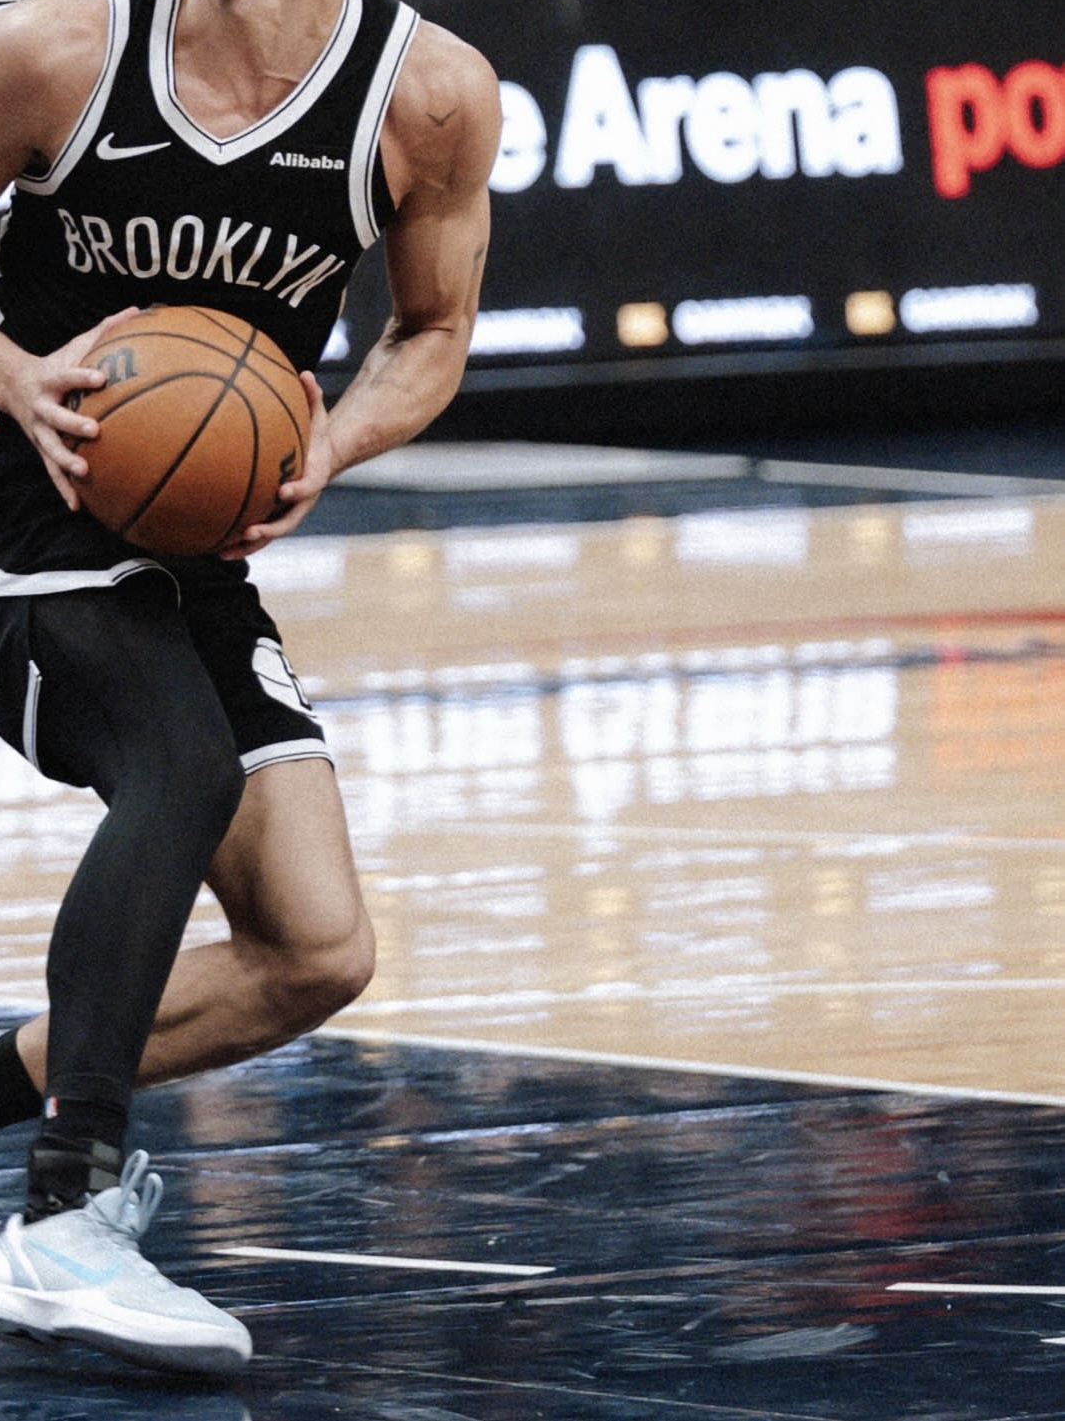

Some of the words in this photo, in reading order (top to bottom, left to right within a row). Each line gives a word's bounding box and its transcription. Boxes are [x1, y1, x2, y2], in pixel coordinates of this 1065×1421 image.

[269, 151, 345, 170] Alibaba
[554, 44, 904, 188] Arena
[58, 208, 345, 309] BROOKLYN
